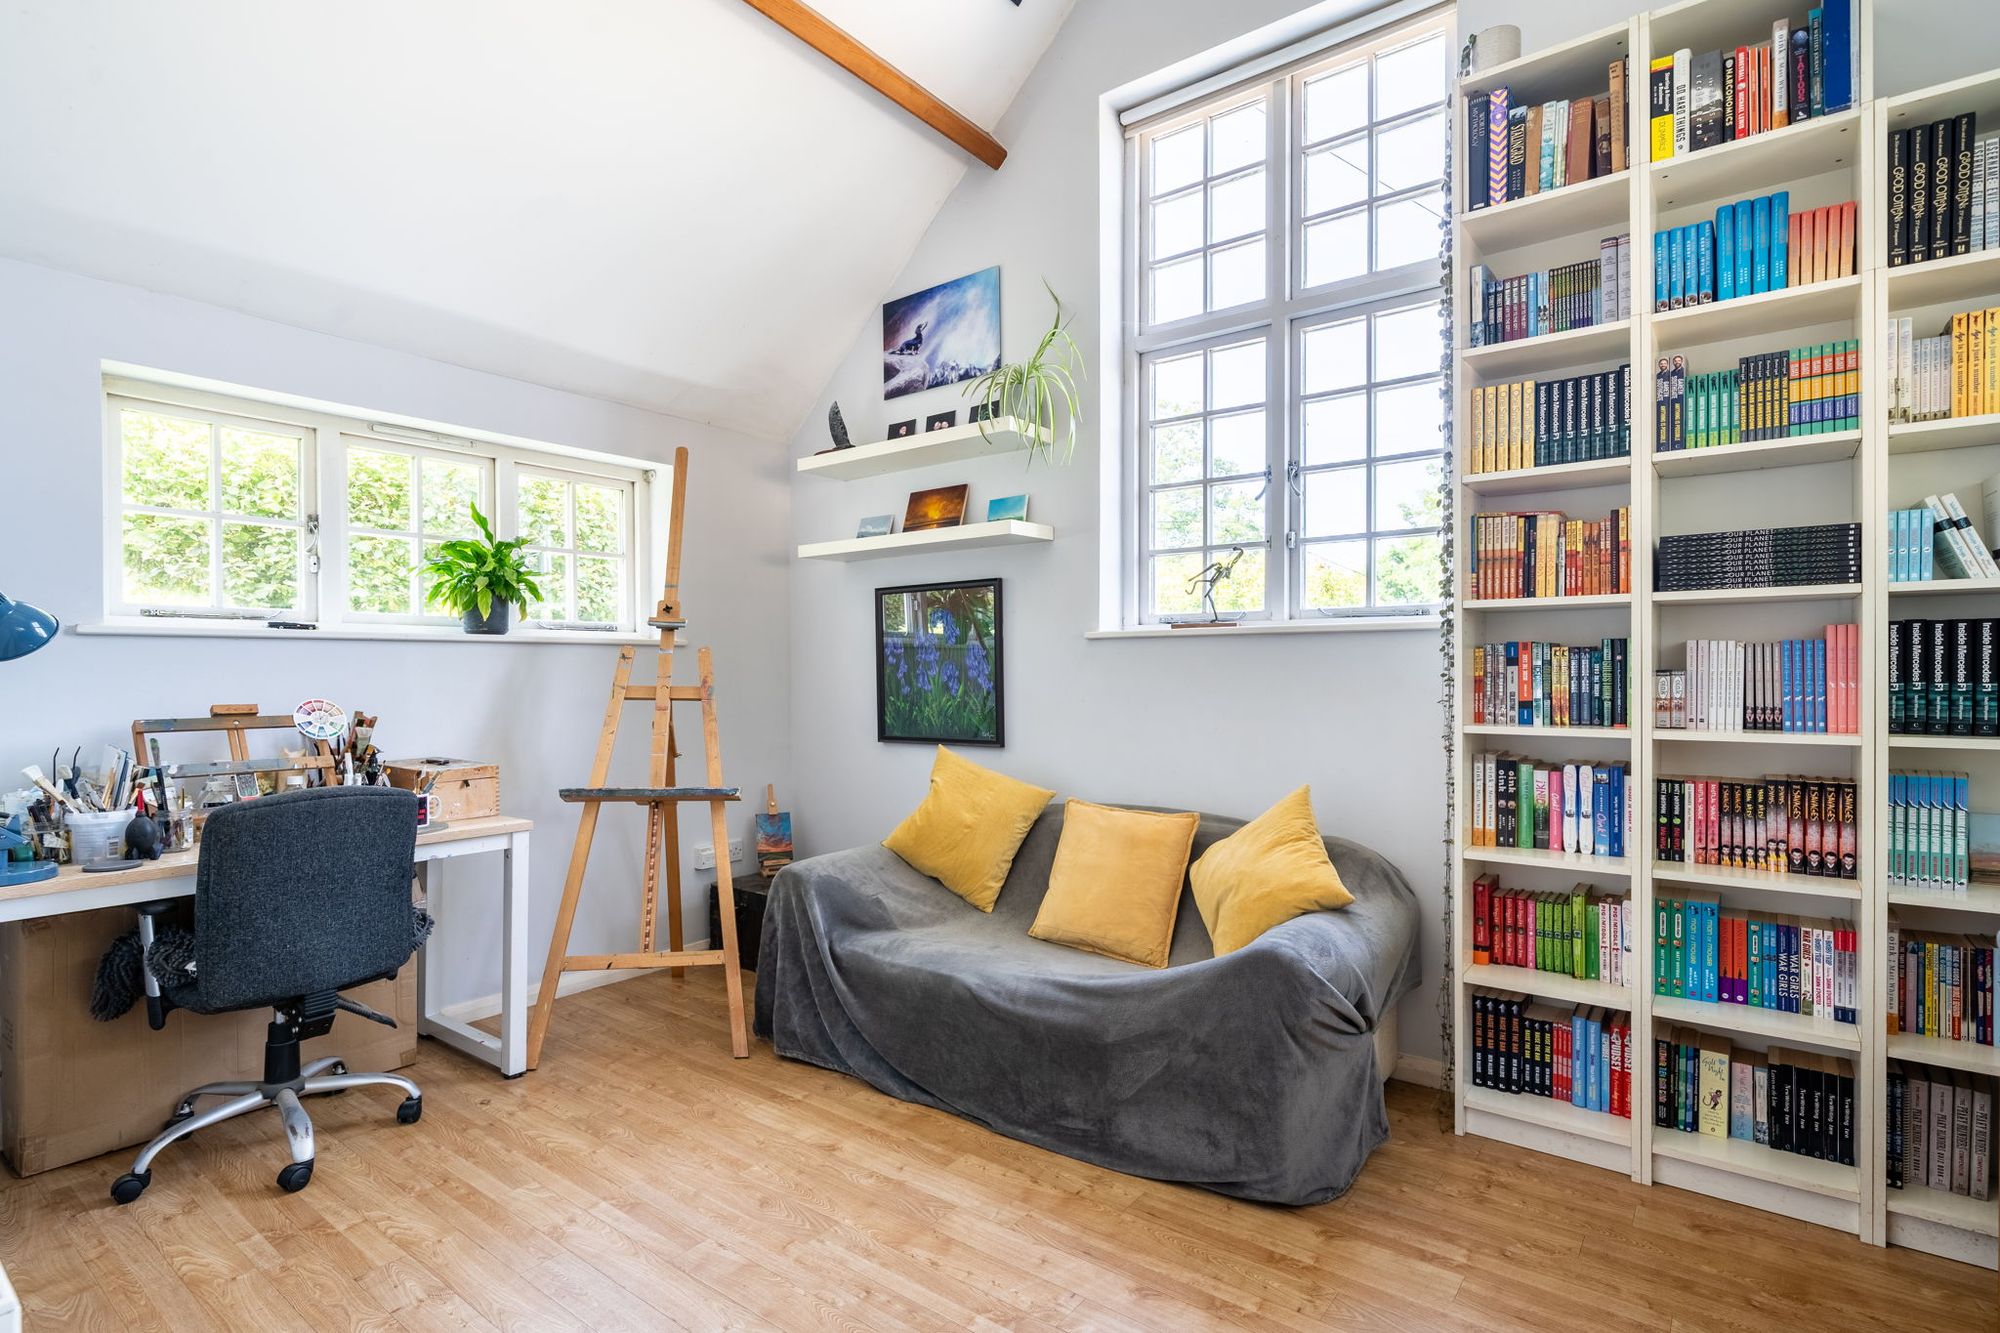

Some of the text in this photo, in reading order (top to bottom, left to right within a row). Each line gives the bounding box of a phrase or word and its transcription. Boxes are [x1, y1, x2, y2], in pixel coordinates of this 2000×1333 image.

[1725, 69, 1734, 126] NARCONOMICS
[1676, 85, 1686, 142] DO HARD THINGS
[1510, 124, 1524, 165] STALINGRAD
[1890, 167, 1904, 222] GOOD OMENS
[1933, 157, 1948, 215] GOOD OMENS
[1956, 152, 1971, 209] GOOD OMENS
[1987, 188, 1998, 203] EVIE
[1972, 191, 1983, 207] EVIE
[1955, 332, 1965, 342] Age
[1971, 329, 1981, 341] Age
[1890, 625, 1899, 646] Inside
[1913, 623, 1921, 644] Inside
[1935, 624, 1943, 644] Inside
[1958, 623, 1967, 644] Inside
[1982, 622, 1991, 644] Inside
[1890, 647, 1899, 682] Mercedes
[1913, 645, 1921, 681] Mercedes
[1935, 646, 1943, 682] Mercedes
[1958, 646, 1967, 682] Mercedes
[1982, 645, 1991, 682] Mercedes
[1551, 793, 1560, 811] Oink!
[1793, 790, 1801, 819] SAVAGES
[1810, 792, 1819, 821] SAVAGES
[1827, 792, 1836, 822] SAVAGES
[1845, 793, 1854, 823] SAVAGES
[1597, 813, 1607, 837] Oink!
[1779, 953, 1787, 997] WAR GIRLS
[1790, 954, 1799, 998] WAR GIRLS
[1611, 1040, 1621, 1071] PUDSEY
[1976, 1112, 1988, 1129] PEAKY
[1975, 1130, 1987, 1156] BLINDERS
